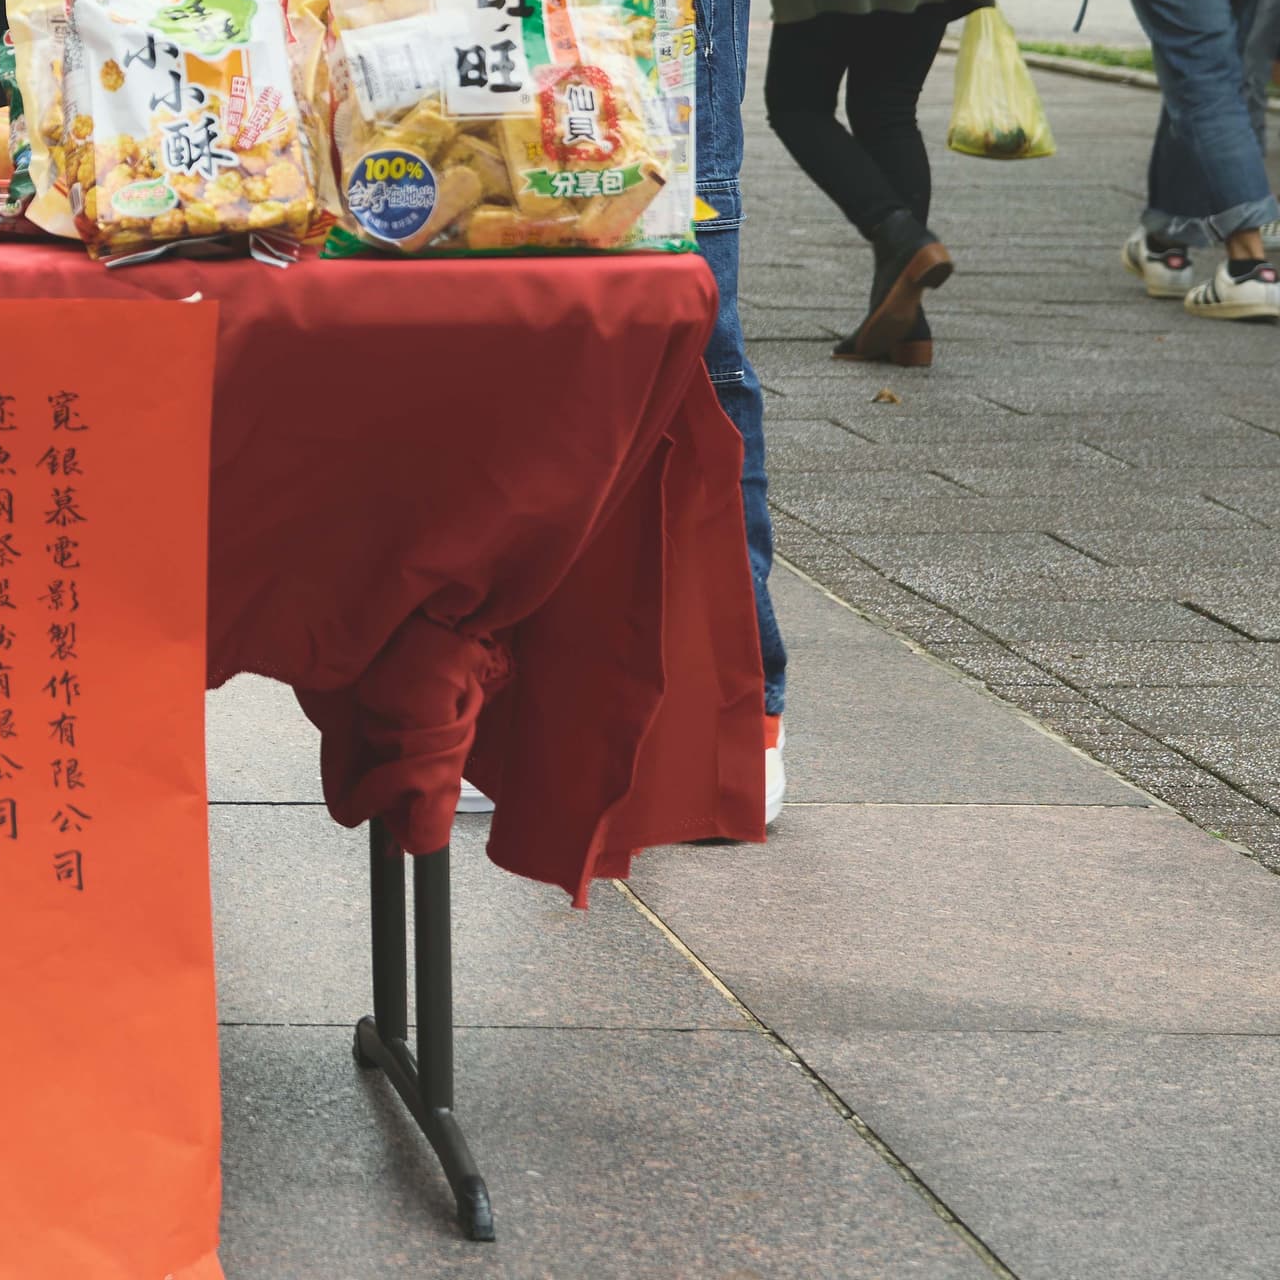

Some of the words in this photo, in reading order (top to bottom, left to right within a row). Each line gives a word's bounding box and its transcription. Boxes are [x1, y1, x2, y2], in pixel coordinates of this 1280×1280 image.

[123, 33, 236, 177] 小小酥
[566, 85, 597, 143] 仙貝
[364, 157, 424, 181] 100%
[551, 169, 625, 198] 分享包
